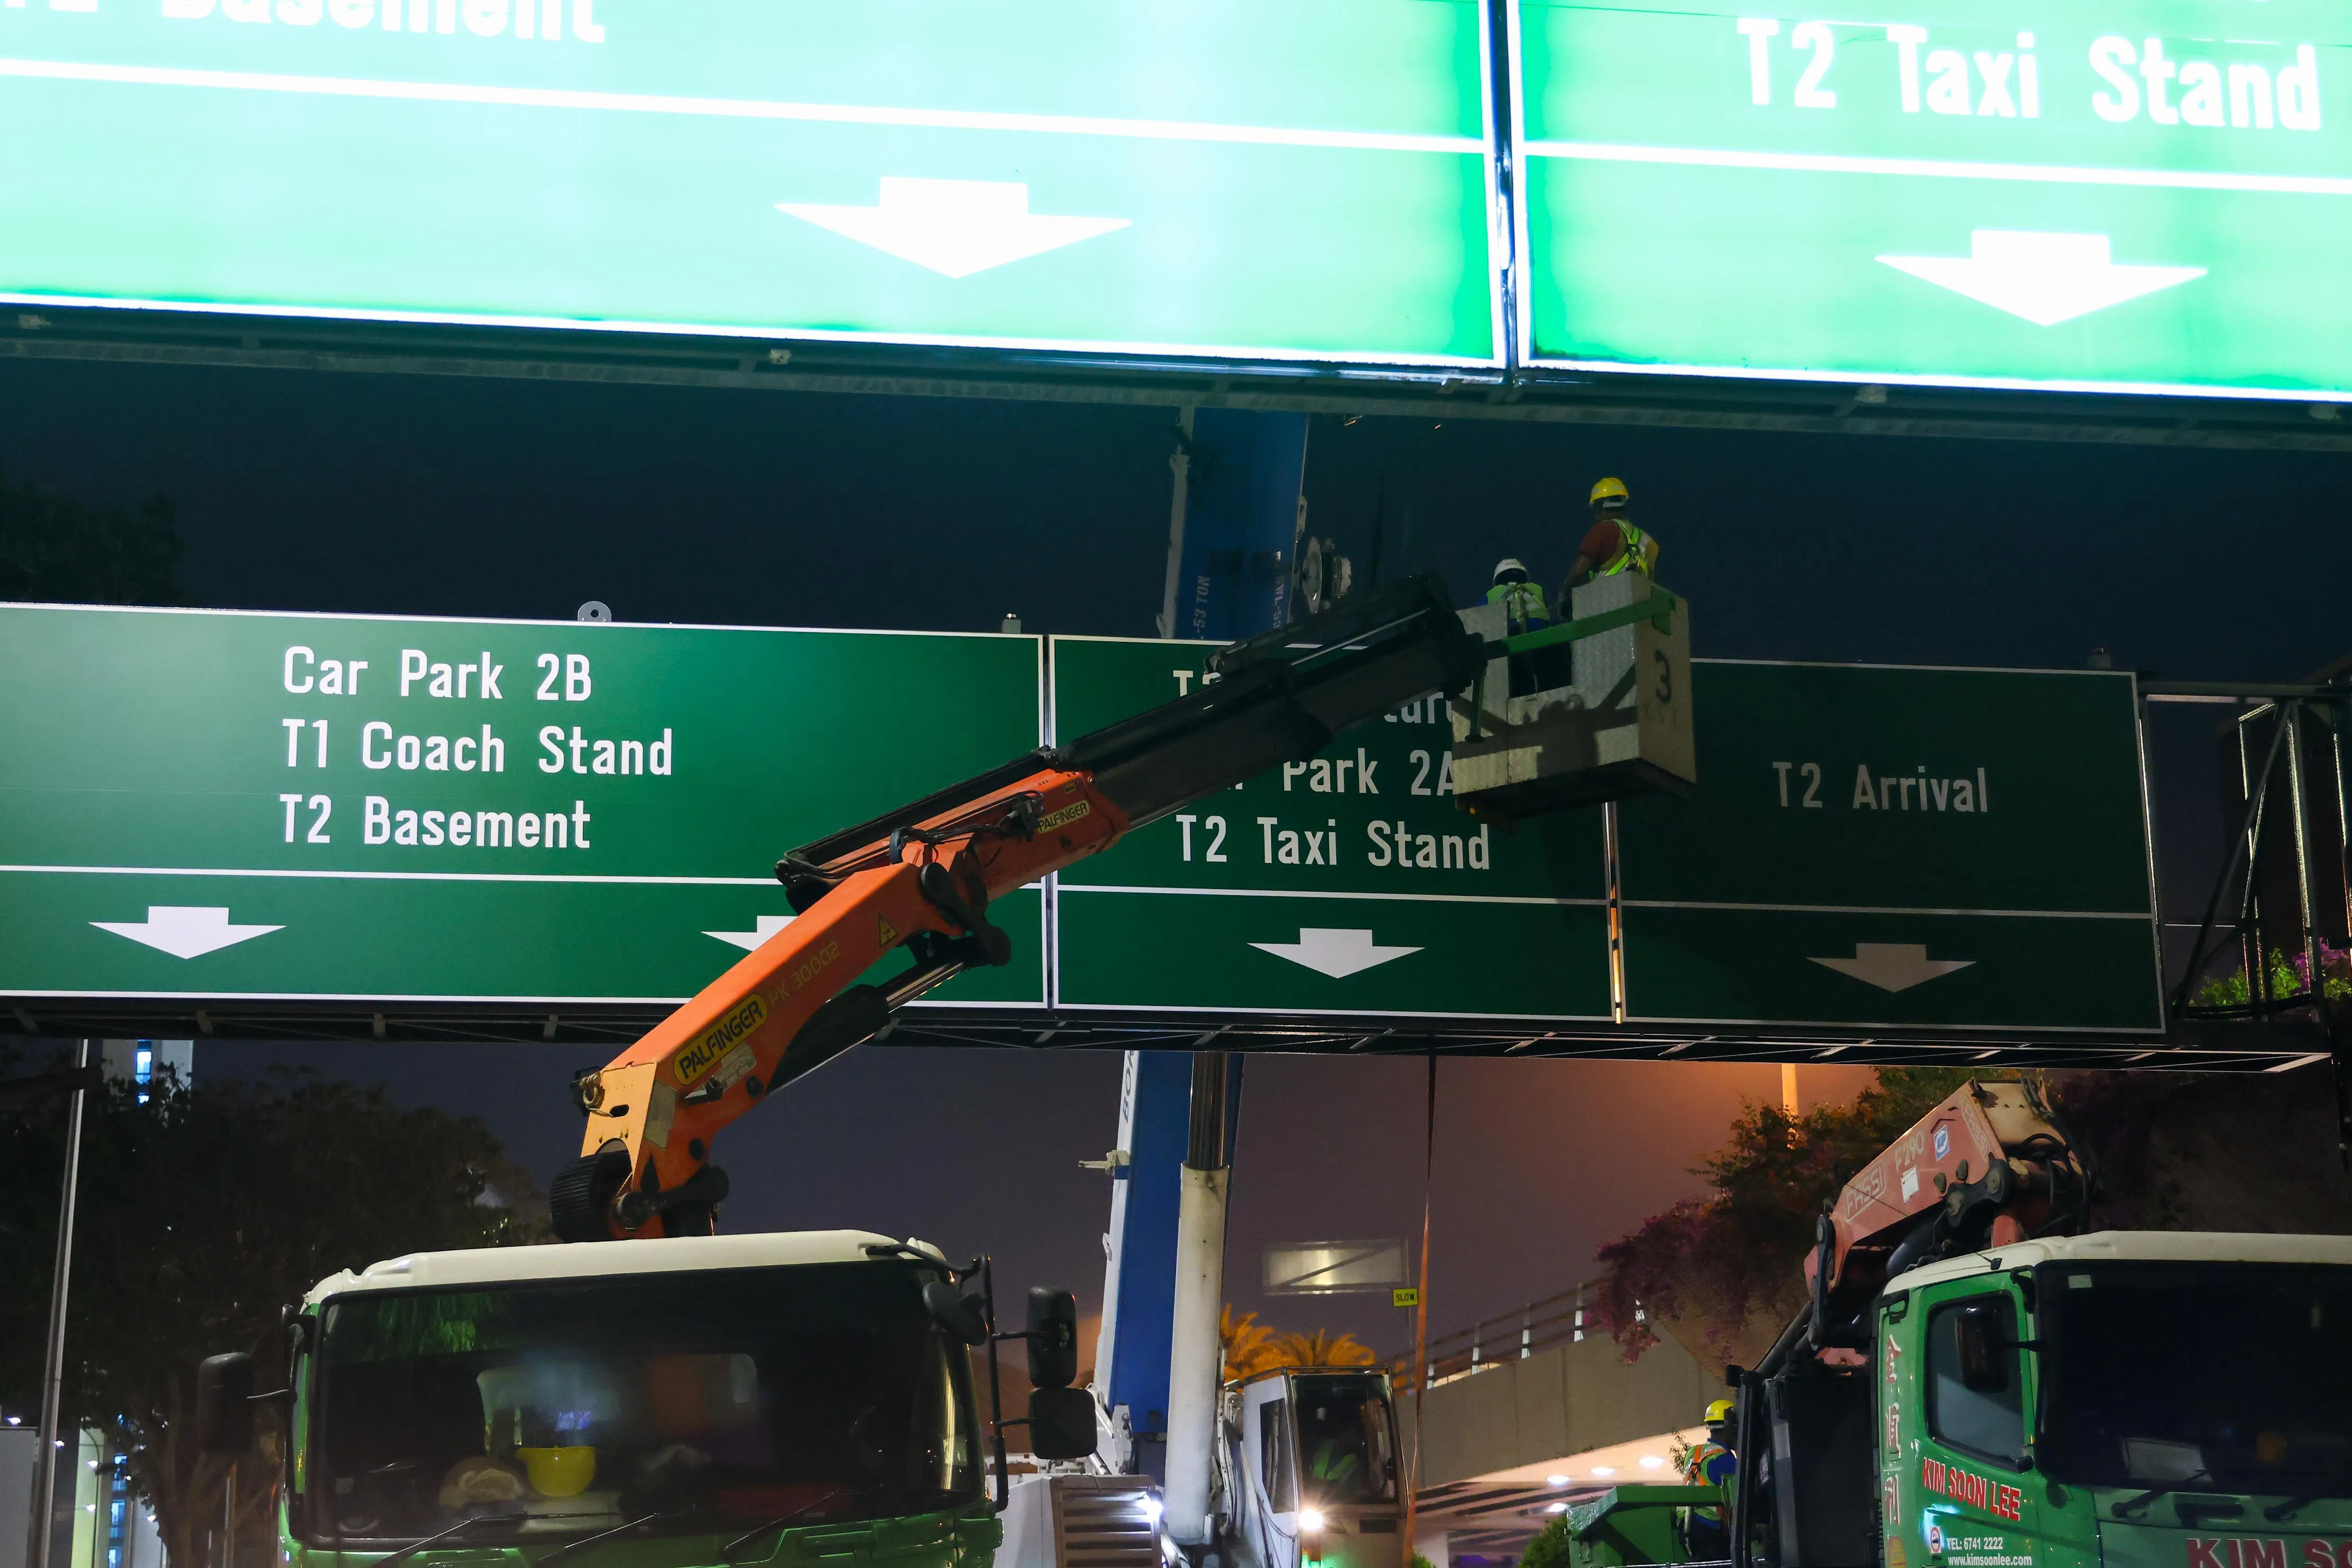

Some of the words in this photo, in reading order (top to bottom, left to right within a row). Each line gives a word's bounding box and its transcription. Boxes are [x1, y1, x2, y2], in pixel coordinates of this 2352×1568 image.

[1737, 18, 1837, 109] T2
[1886, 25, 2040, 119] Taxi
[2089, 36, 2321, 131] Stand
[285, 646, 367, 695] Car
[401, 649, 503, 699] Park
[537, 654, 591, 700] 2B
[1173, 670, 1221, 697] T
[1655, 650, 1672, 704] 3
[283, 719, 328, 767] T1
[363, 722, 504, 772] Coach
[539, 726, 672, 775] Stand
[1284, 748, 1379, 793] Park
[1773, 762, 1822, 807] T2
[1854, 765, 1987, 812] Arrival
[280, 794, 331, 843] T2
[364, 796, 590, 848] Basement
[1038, 802, 1088, 832] PALFINGER
[1176, 814, 1227, 862] T2
[1258, 817, 1337, 865] Taxi
[1367, 820, 1489, 869] Stand
[679, 1000, 764, 1079] PALFINGER
[1846, 1166, 1883, 1215] FASSI
[1396, 1293, 1415, 1301] SLOW
[1923, 1456, 1946, 1495] KIM
[1948, 1467, 1987, 1510] SOON
[1990, 1481, 2021, 1521] LEE
[1947, 1538, 1962, 1550] TEL:
[1964, 1537, 1981, 1550] 6741
[1983, 1537, 2003, 1550] 2222
[1948, 1553, 2032, 1566] www.kimsoonlee.com
[2187, 1538, 2288, 1568] KIM
